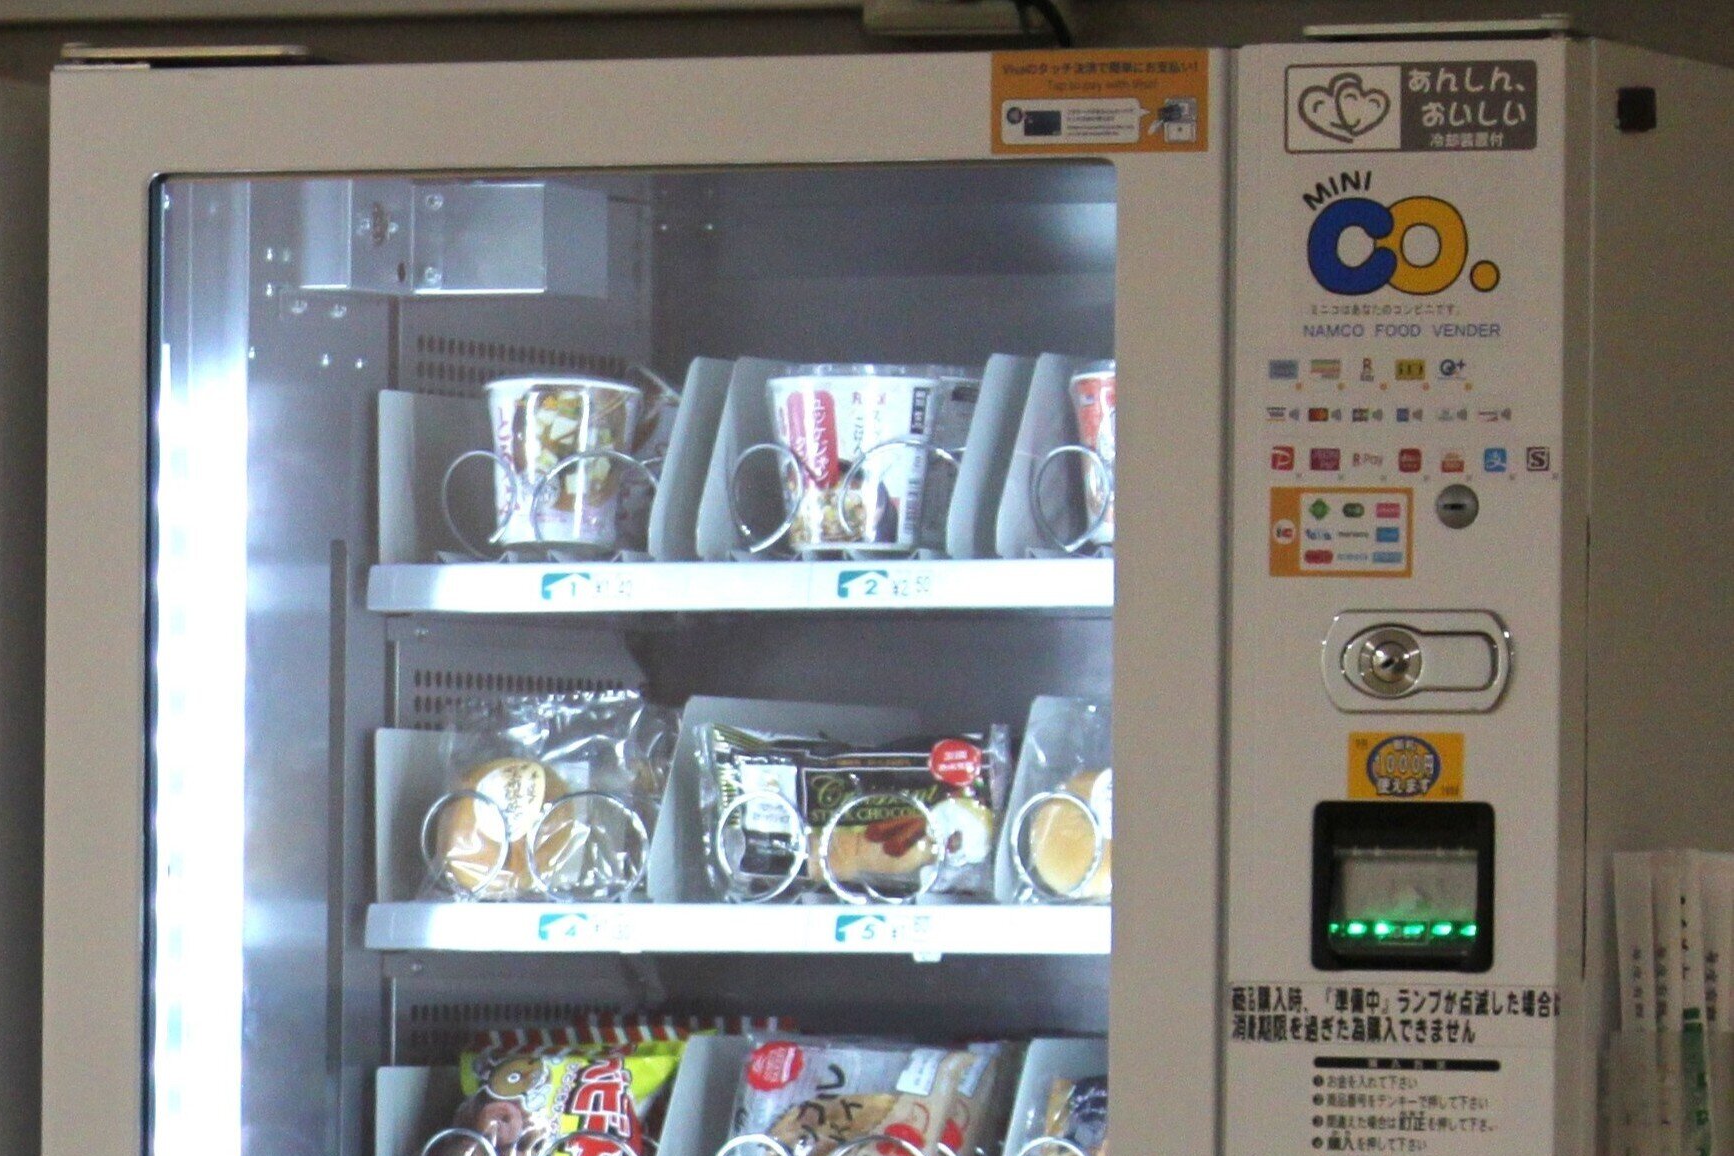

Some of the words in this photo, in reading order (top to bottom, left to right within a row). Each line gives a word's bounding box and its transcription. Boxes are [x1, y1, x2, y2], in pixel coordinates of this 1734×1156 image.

[1408, 66, 1526, 93] あんしん、
[1422, 101, 1526, 127] おいしい
[1302, 169, 1373, 211] MINI
[1303, 324, 1364, 338] NAMCO
[1375, 324, 1421, 338] FOOD
[1432, 323, 1501, 338] VENDER
